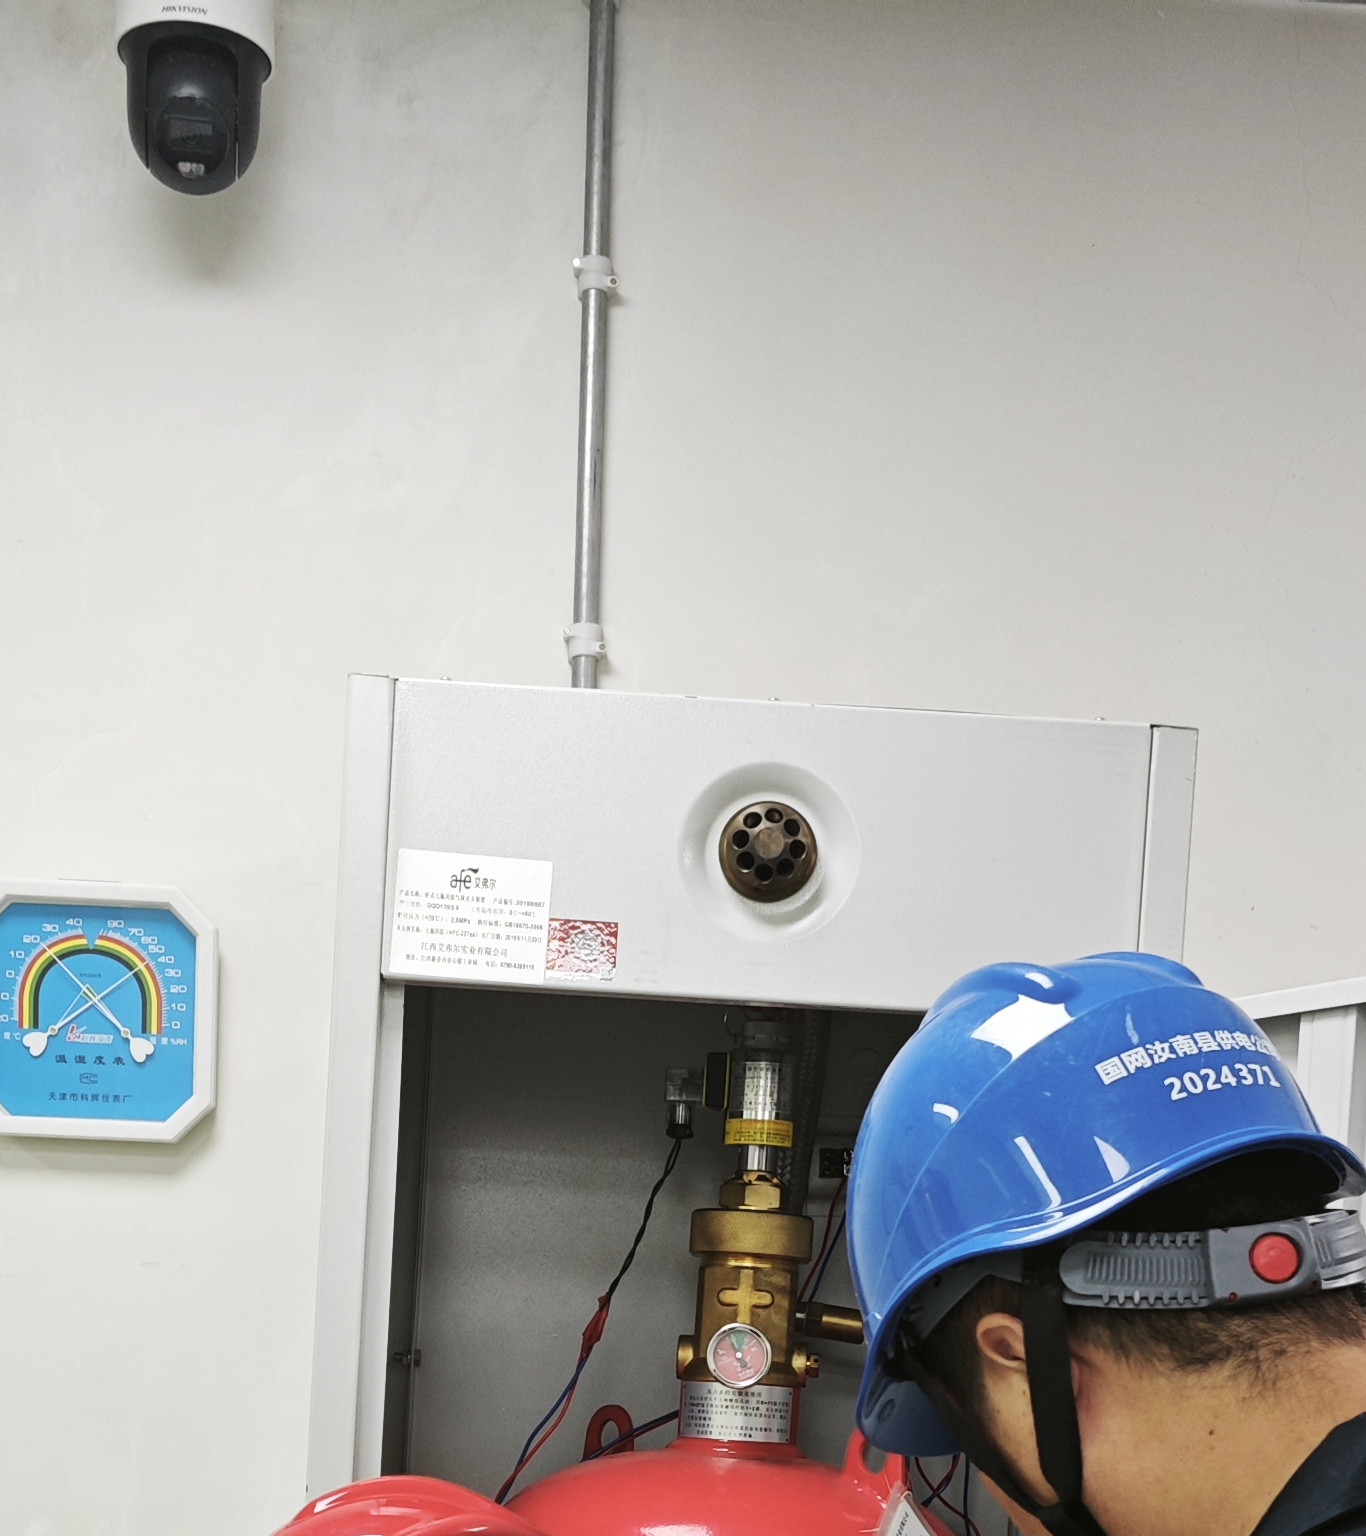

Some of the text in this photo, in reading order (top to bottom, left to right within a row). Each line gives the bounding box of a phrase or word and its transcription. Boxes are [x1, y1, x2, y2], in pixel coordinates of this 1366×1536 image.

[161, 5, 208, 15] HIKVISION
[65, 918, 83, 927] 40
[42, 924, 59, 933] 30
[128, 928, 144, 936] 70
[23, 935, 40, 943] 20
[148, 945, 165, 953] 50
[9, 951, 25, 959] 10
[157, 956, 175, 964] 40
[5, 970, 15, 978] 0
[164, 969, 181, 977] 30
[170, 985, 187, 993] 20
[170, 1003, 187, 1011] 10
[171, 1021, 181, 1029] 0
[1164, 1063, 1281, 1101] 2024371
